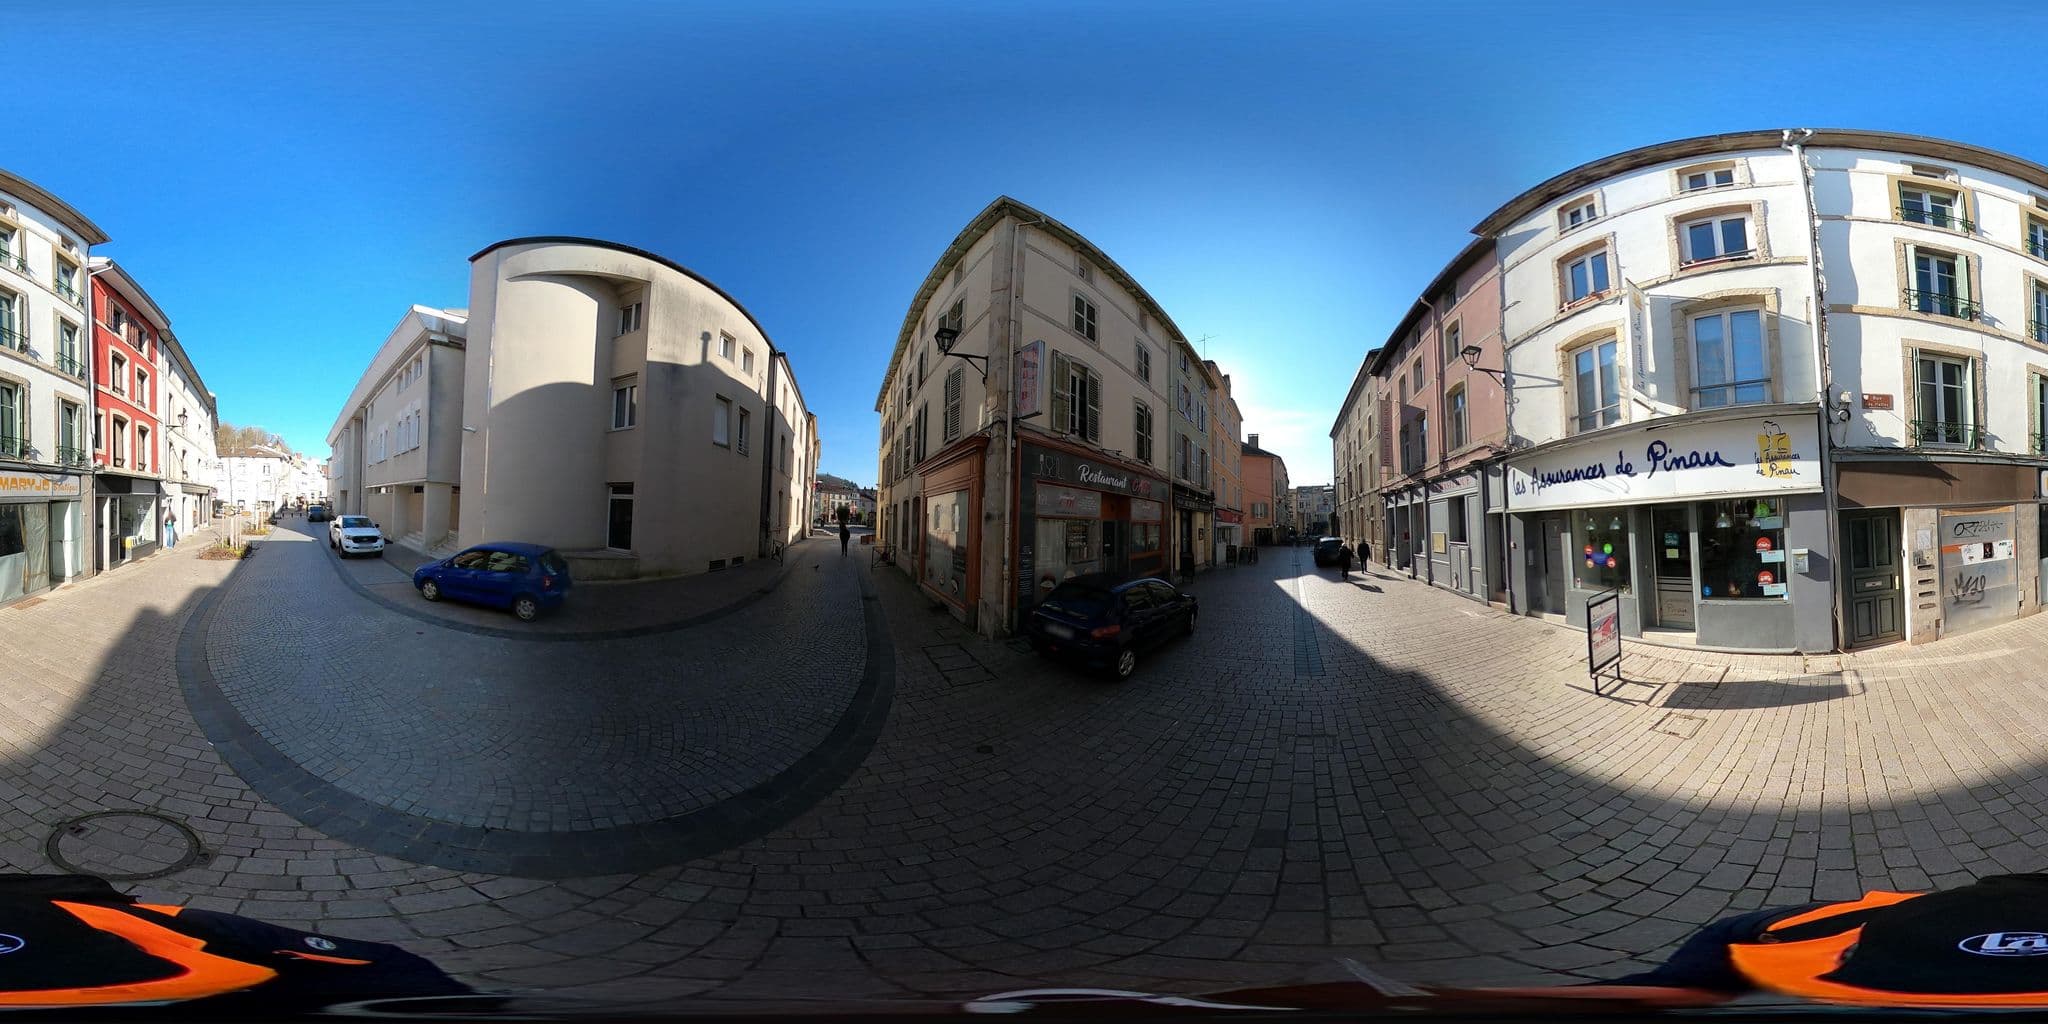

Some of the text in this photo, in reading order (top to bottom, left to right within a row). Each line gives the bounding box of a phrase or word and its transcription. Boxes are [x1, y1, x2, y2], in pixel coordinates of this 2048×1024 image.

[1530, 461, 1607, 496] Assurances
[1615, 451, 1637, 477] de
[1647, 439, 1736, 479] Pinau
[1765, 452, 1801, 463] Assurances
[1077, 463, 1129, 489] Restaurant
[1756, 462, 1801, 478] de Pinau
